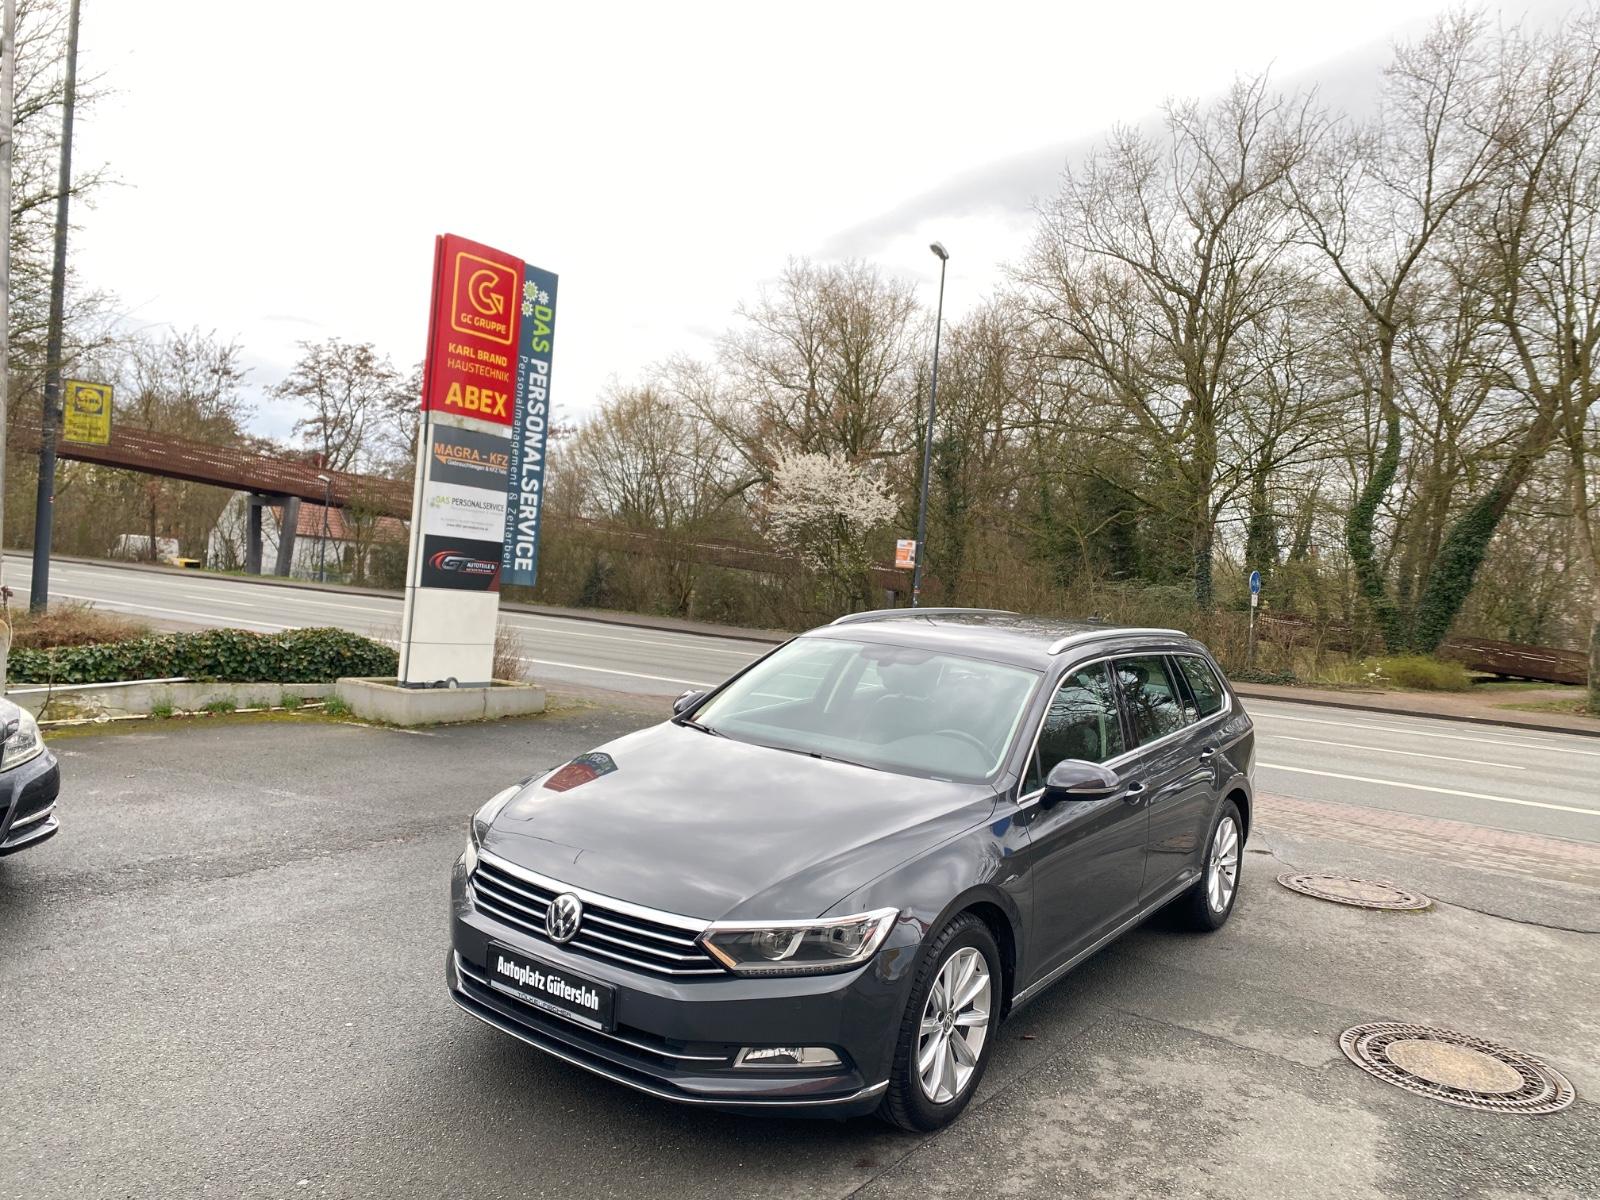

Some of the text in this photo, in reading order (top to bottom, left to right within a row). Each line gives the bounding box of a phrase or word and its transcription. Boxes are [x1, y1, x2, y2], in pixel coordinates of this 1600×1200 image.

[461, 313, 506, 334] GC GRUPPE
[448, 342, 508, 366] KARL BRAND
[447, 358, 510, 382] HAUSTECHNIK
[445, 382, 508, 417] ABEX
[514, 305, 553, 571] DAS PERSONALSERVICE
[434, 442, 480, 461] MAGRA
[489, 452, 509, 466] KFZ
[503, 355, 529, 568] Personalmanagement & Zeitarbeit
[451, 497, 505, 512] PERSONALSERVICE
[497, 955, 546, 991] Autoplatz
[546, 974, 599, 1011] Gütersloh
